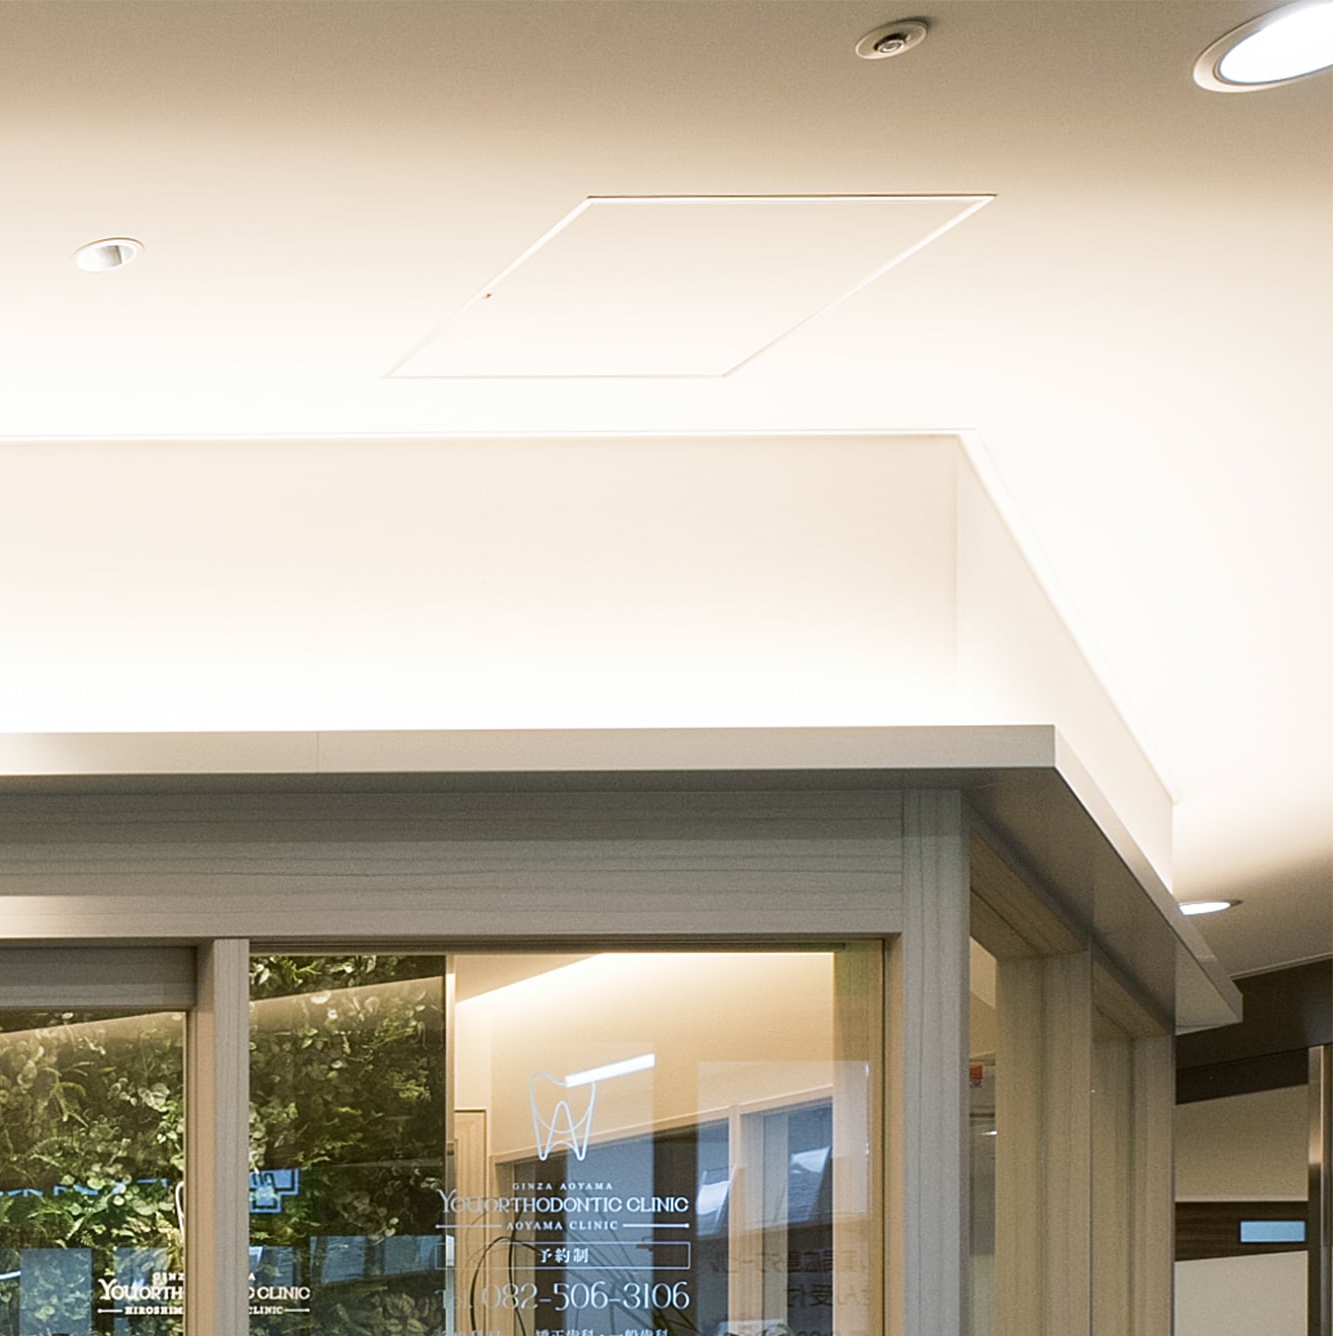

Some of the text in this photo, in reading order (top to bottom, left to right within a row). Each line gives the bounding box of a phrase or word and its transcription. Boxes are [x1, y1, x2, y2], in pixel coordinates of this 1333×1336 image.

[512, 1182, 613, 1191] GINZA AOYAMA
[626, 1196, 690, 1213] CLINIC
[507, 1220, 619, 1231] AOYAMA CLINIC
[539, 1247, 590, 1264] 予約制
[152, 1272, 184, 1282] GINZ
[256, 1286, 311, 1300] CLINIC
[482, 1280, 691, 1312] 082-506-3106
[124, 1306, 184, 1316] HIROSHIM
